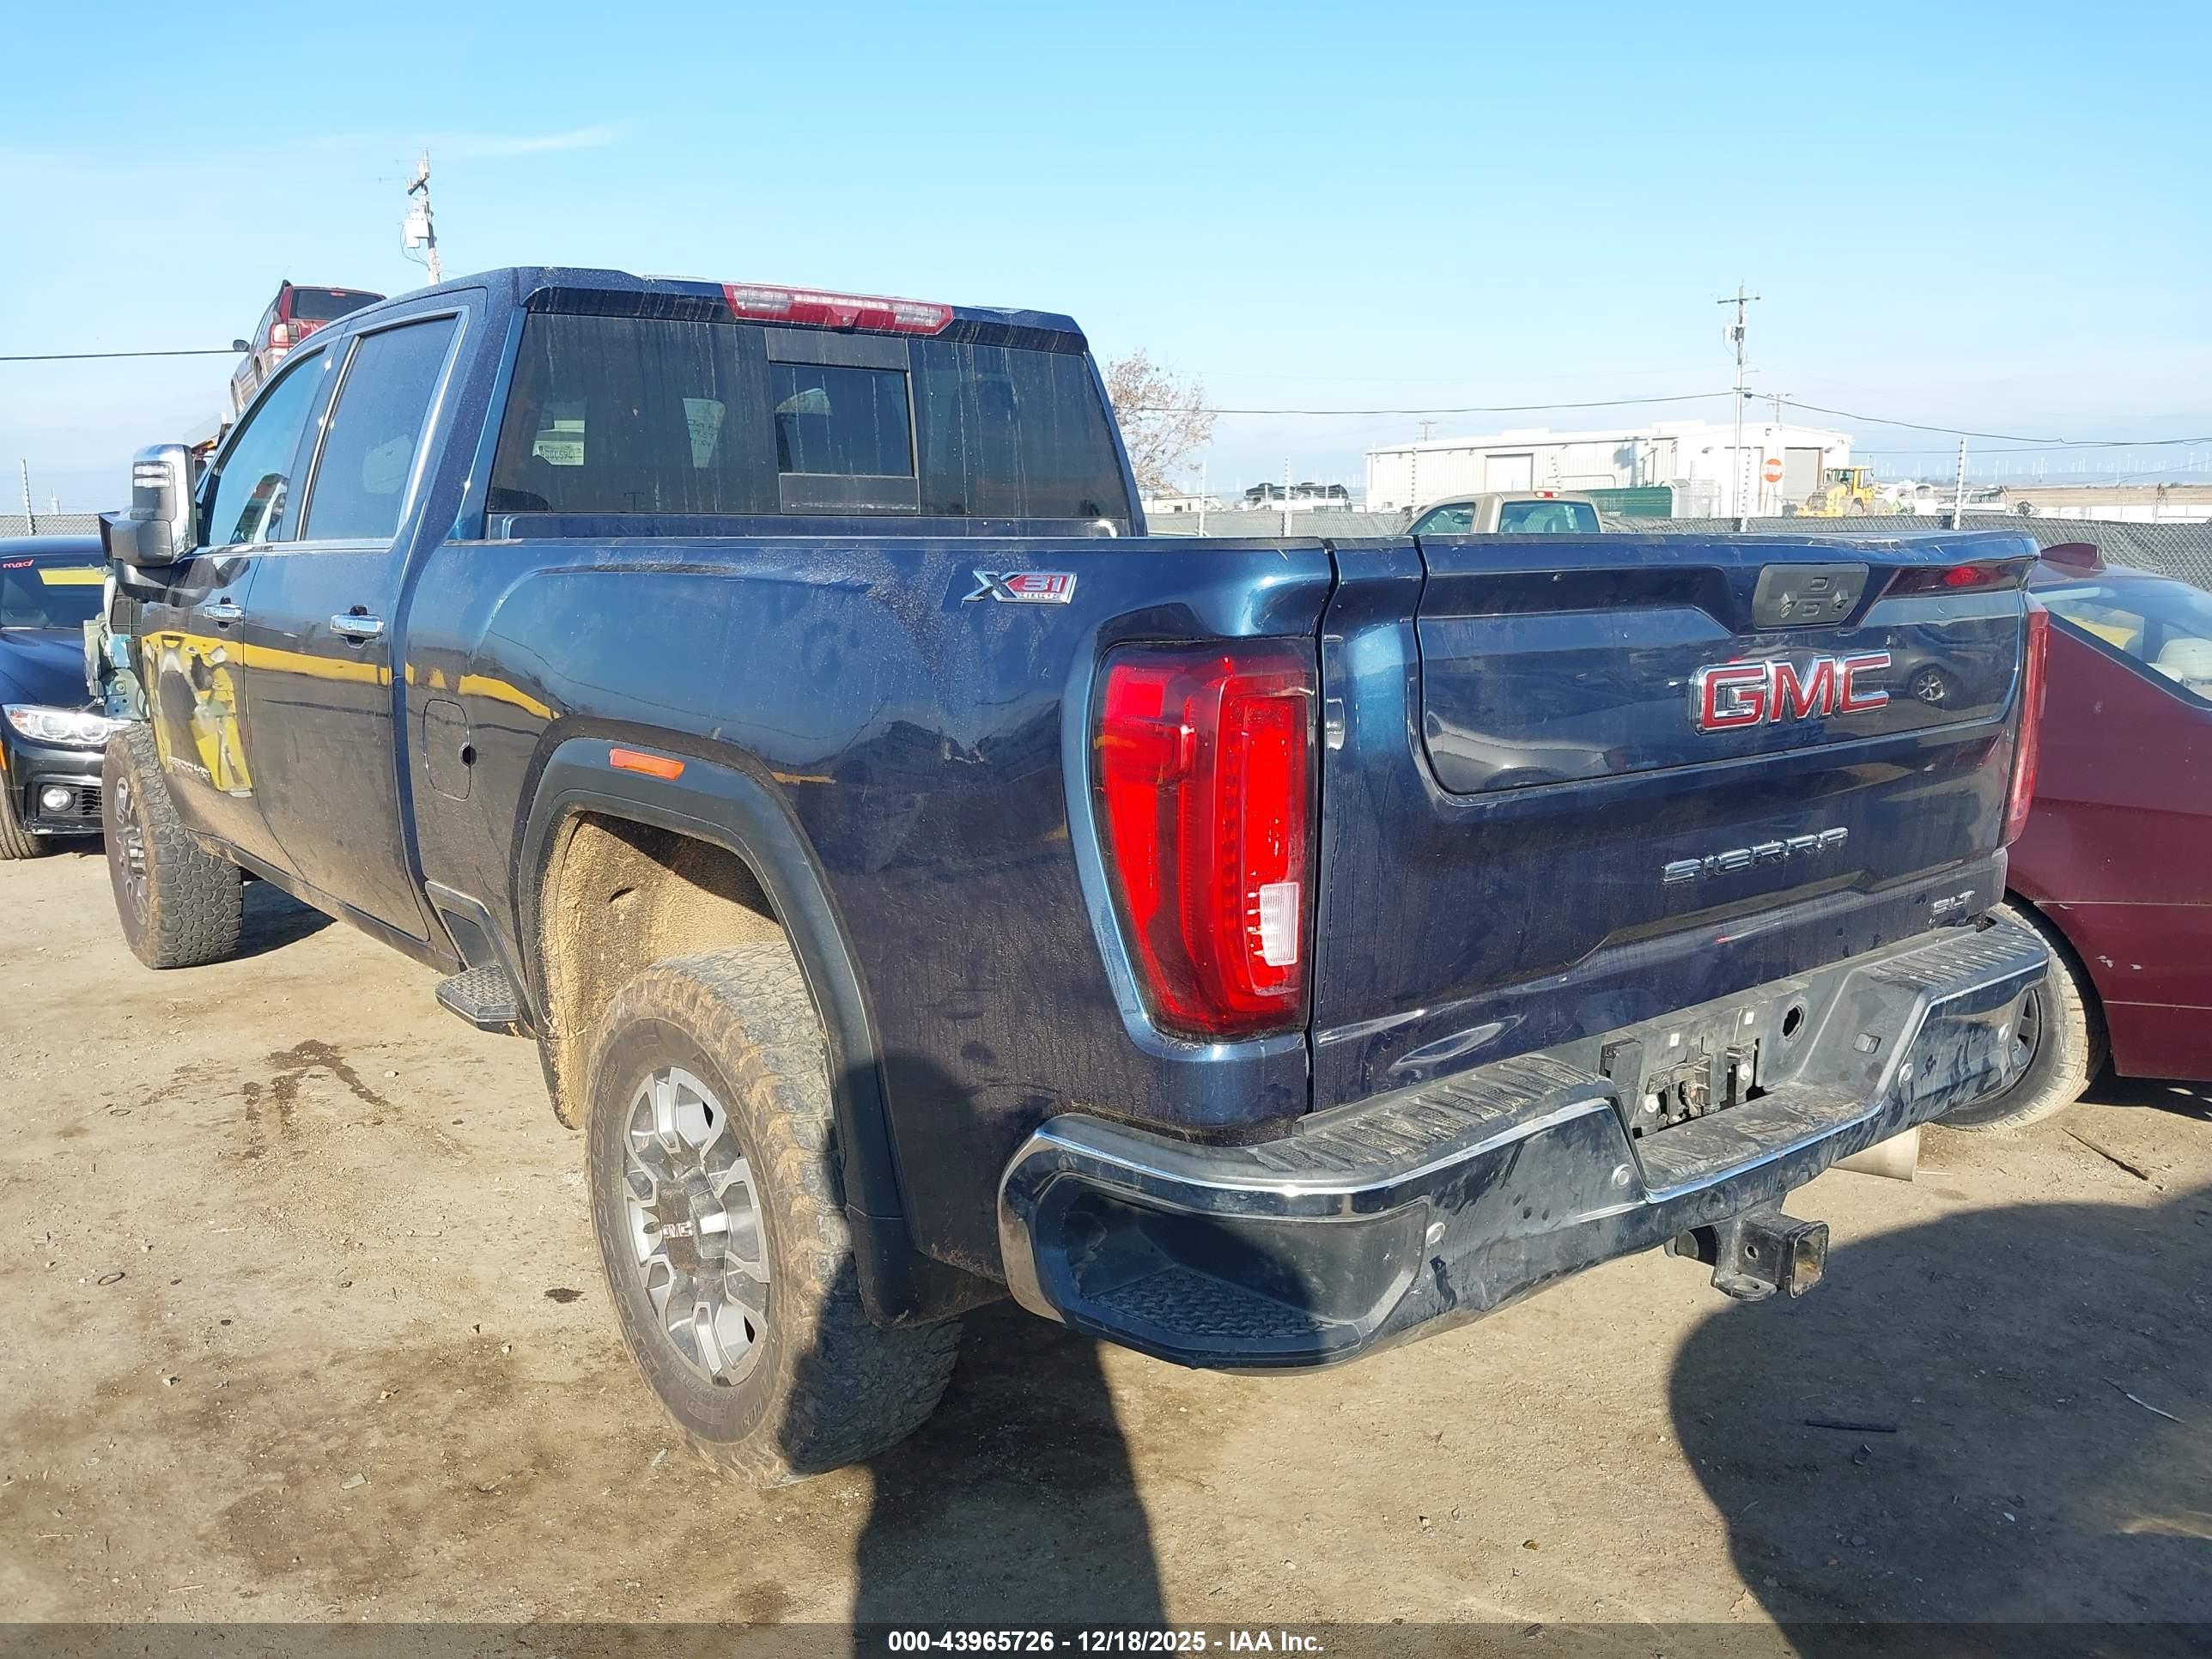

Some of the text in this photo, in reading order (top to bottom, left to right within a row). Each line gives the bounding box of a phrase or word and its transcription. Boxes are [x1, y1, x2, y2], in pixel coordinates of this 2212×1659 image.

[1761, 464, 1784, 475] STOP
[962, 570, 1078, 604] X31
[1688, 649, 1892, 736] GMC
[1662, 826, 1849, 885] SIERRA
[662, 1221, 693, 1238] GMC
